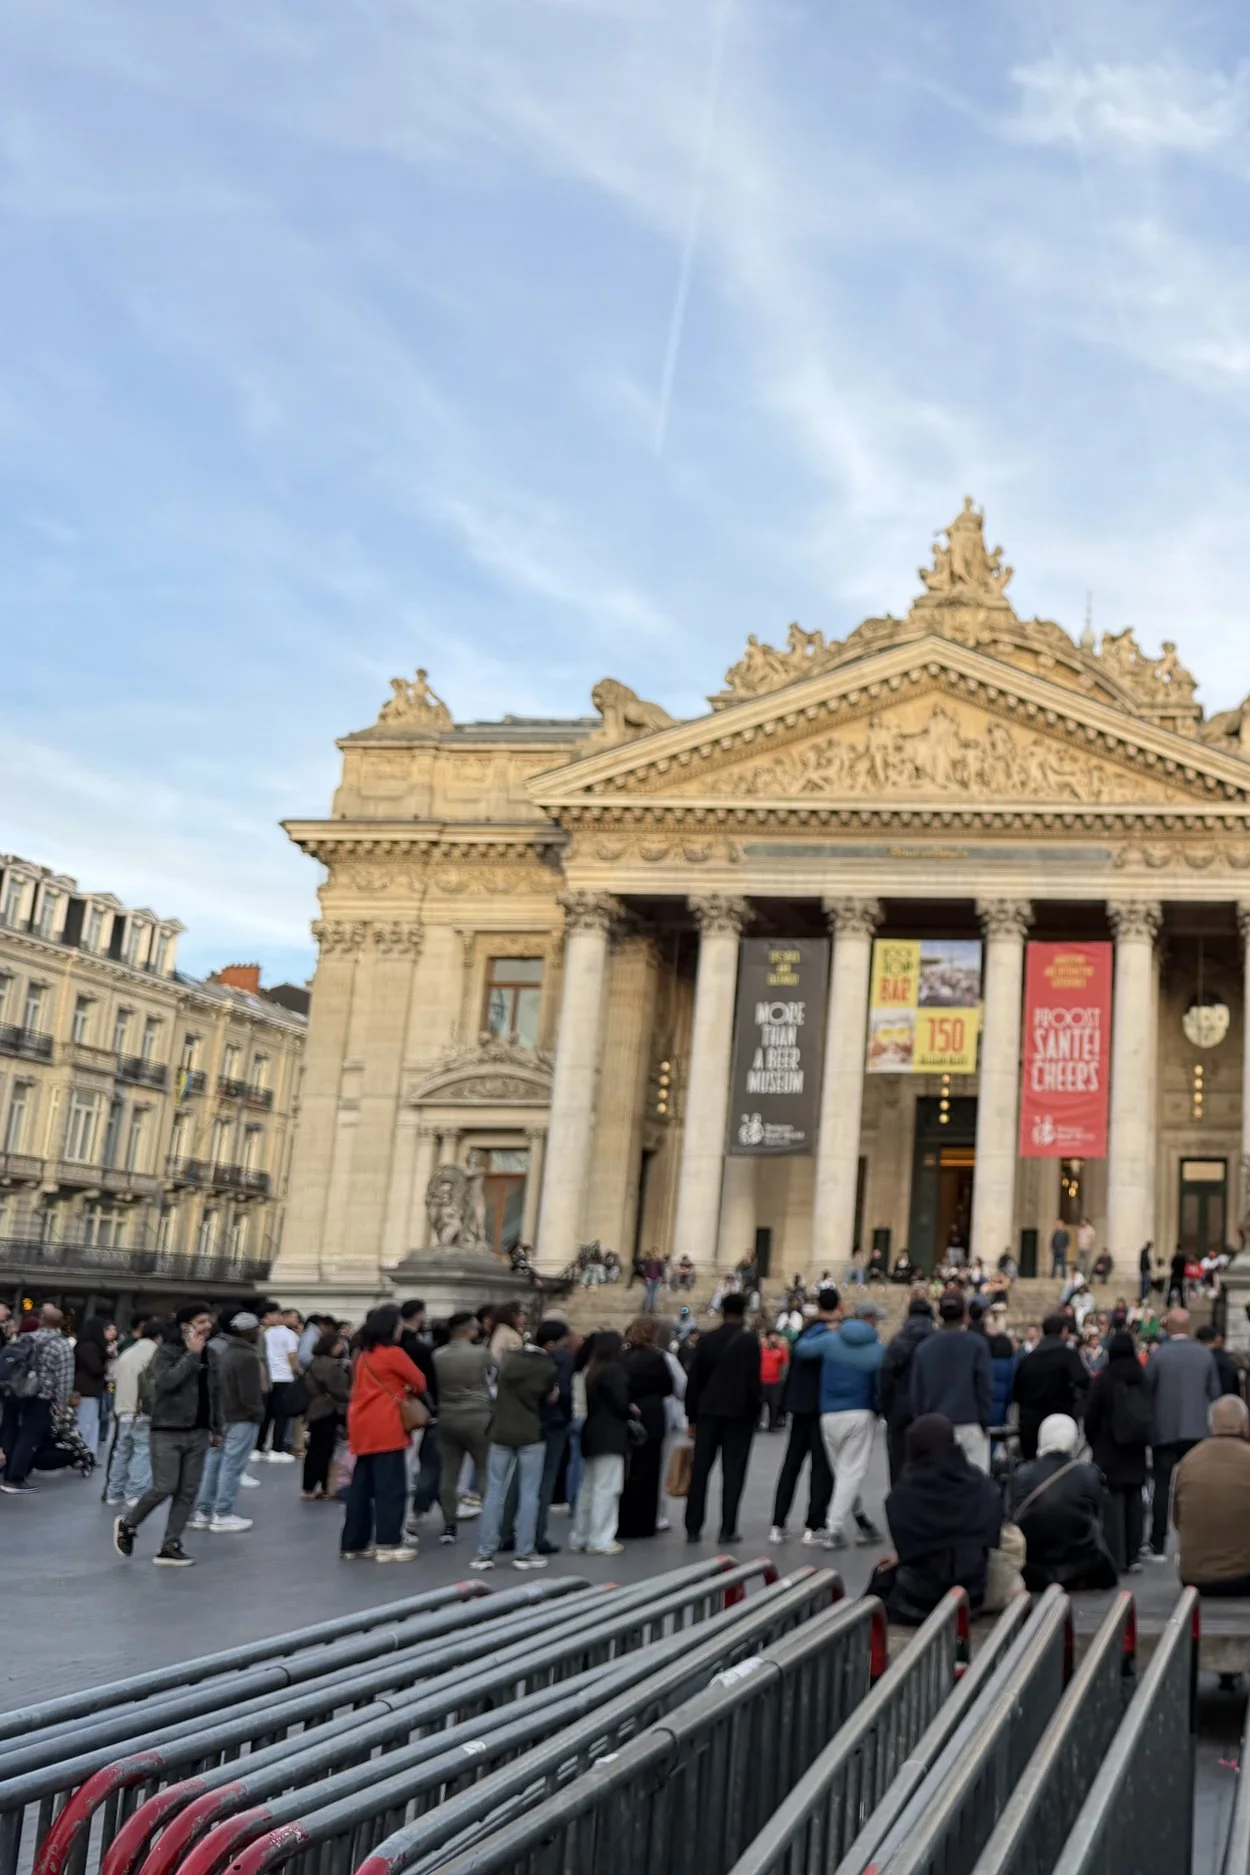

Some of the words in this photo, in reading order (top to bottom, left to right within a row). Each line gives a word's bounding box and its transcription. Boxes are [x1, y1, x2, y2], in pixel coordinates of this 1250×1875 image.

[880, 976, 911, 1002] BAR
[755, 1001, 805, 1026] MORE
[761, 1024, 797, 1047] THAN
[928, 1017, 964, 1052] 150
[752, 1047, 764, 1070] A
[765, 1046, 800, 1070] BEER
[746, 1069, 804, 1094] MUSEUM
[1031, 1060, 1099, 1092] CHEERS
